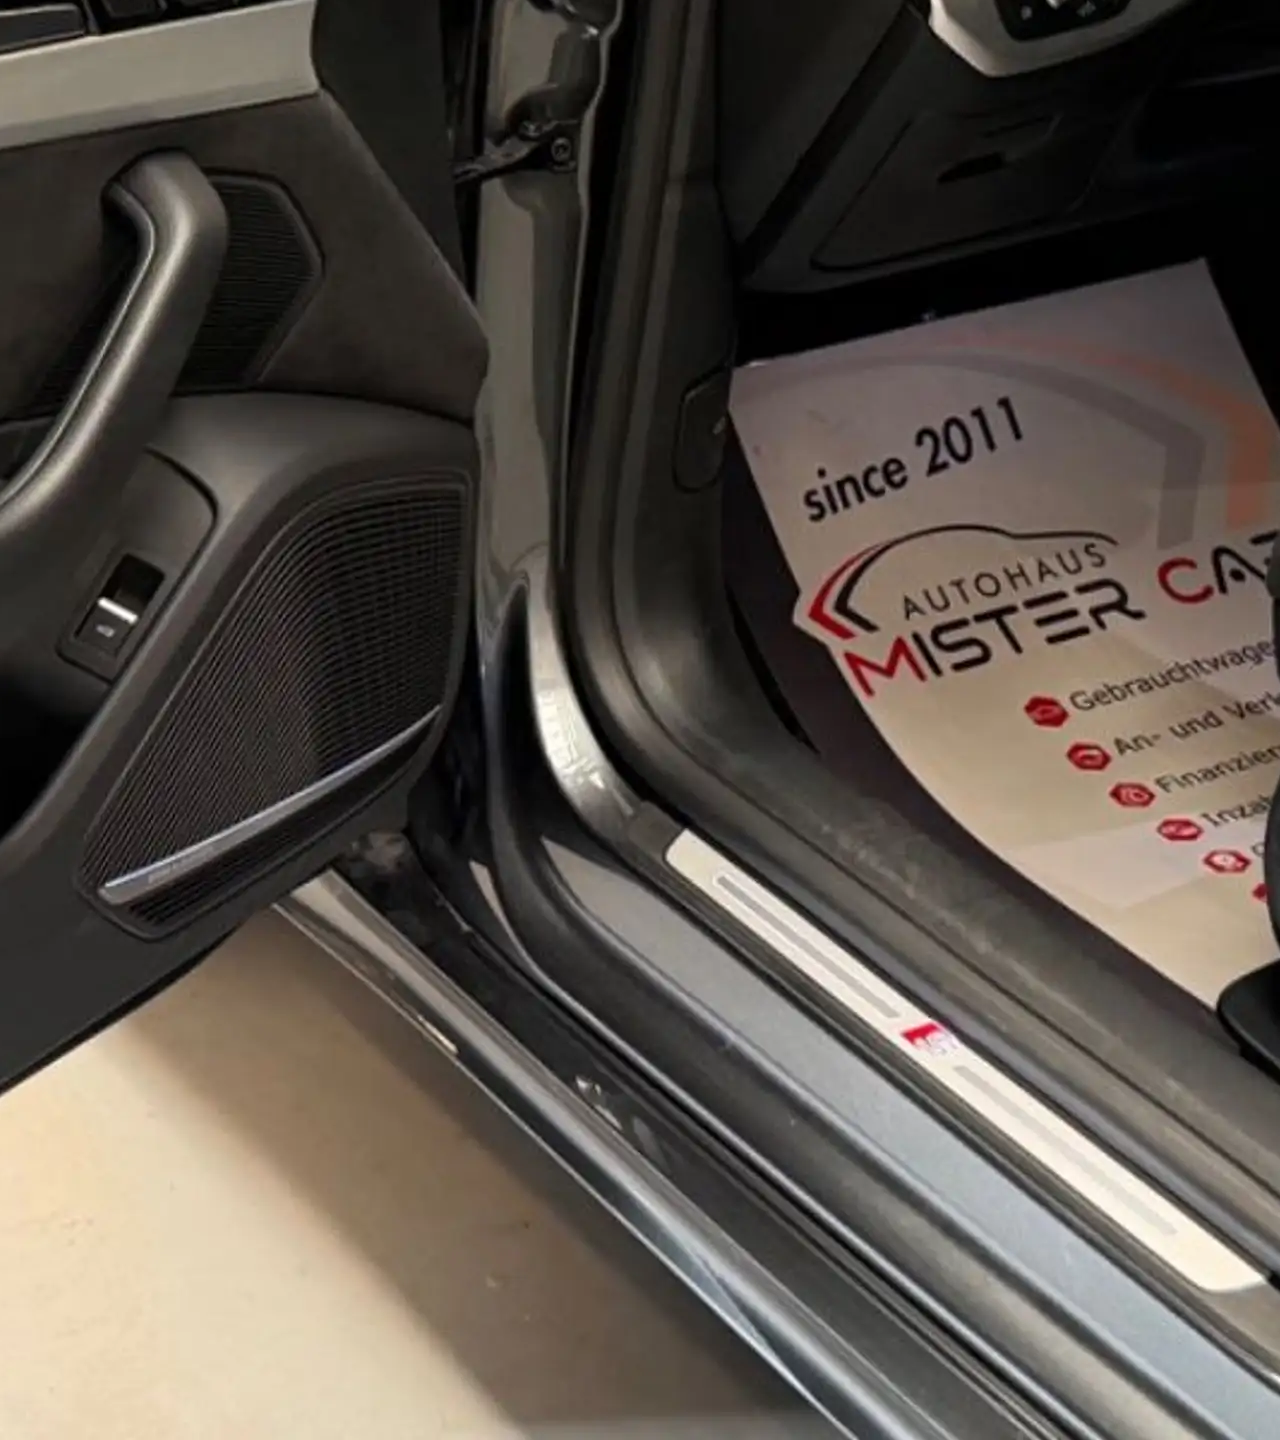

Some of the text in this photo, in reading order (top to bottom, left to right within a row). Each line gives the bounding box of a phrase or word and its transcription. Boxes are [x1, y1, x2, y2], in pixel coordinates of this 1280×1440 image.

[803, 395, 1024, 523] since 2011
[902, 541, 1107, 621] AUTOHAUS
[842, 576, 1146, 698] MISTER
[1113, 733, 1162, 757] An-
[1169, 710, 1224, 740] und
